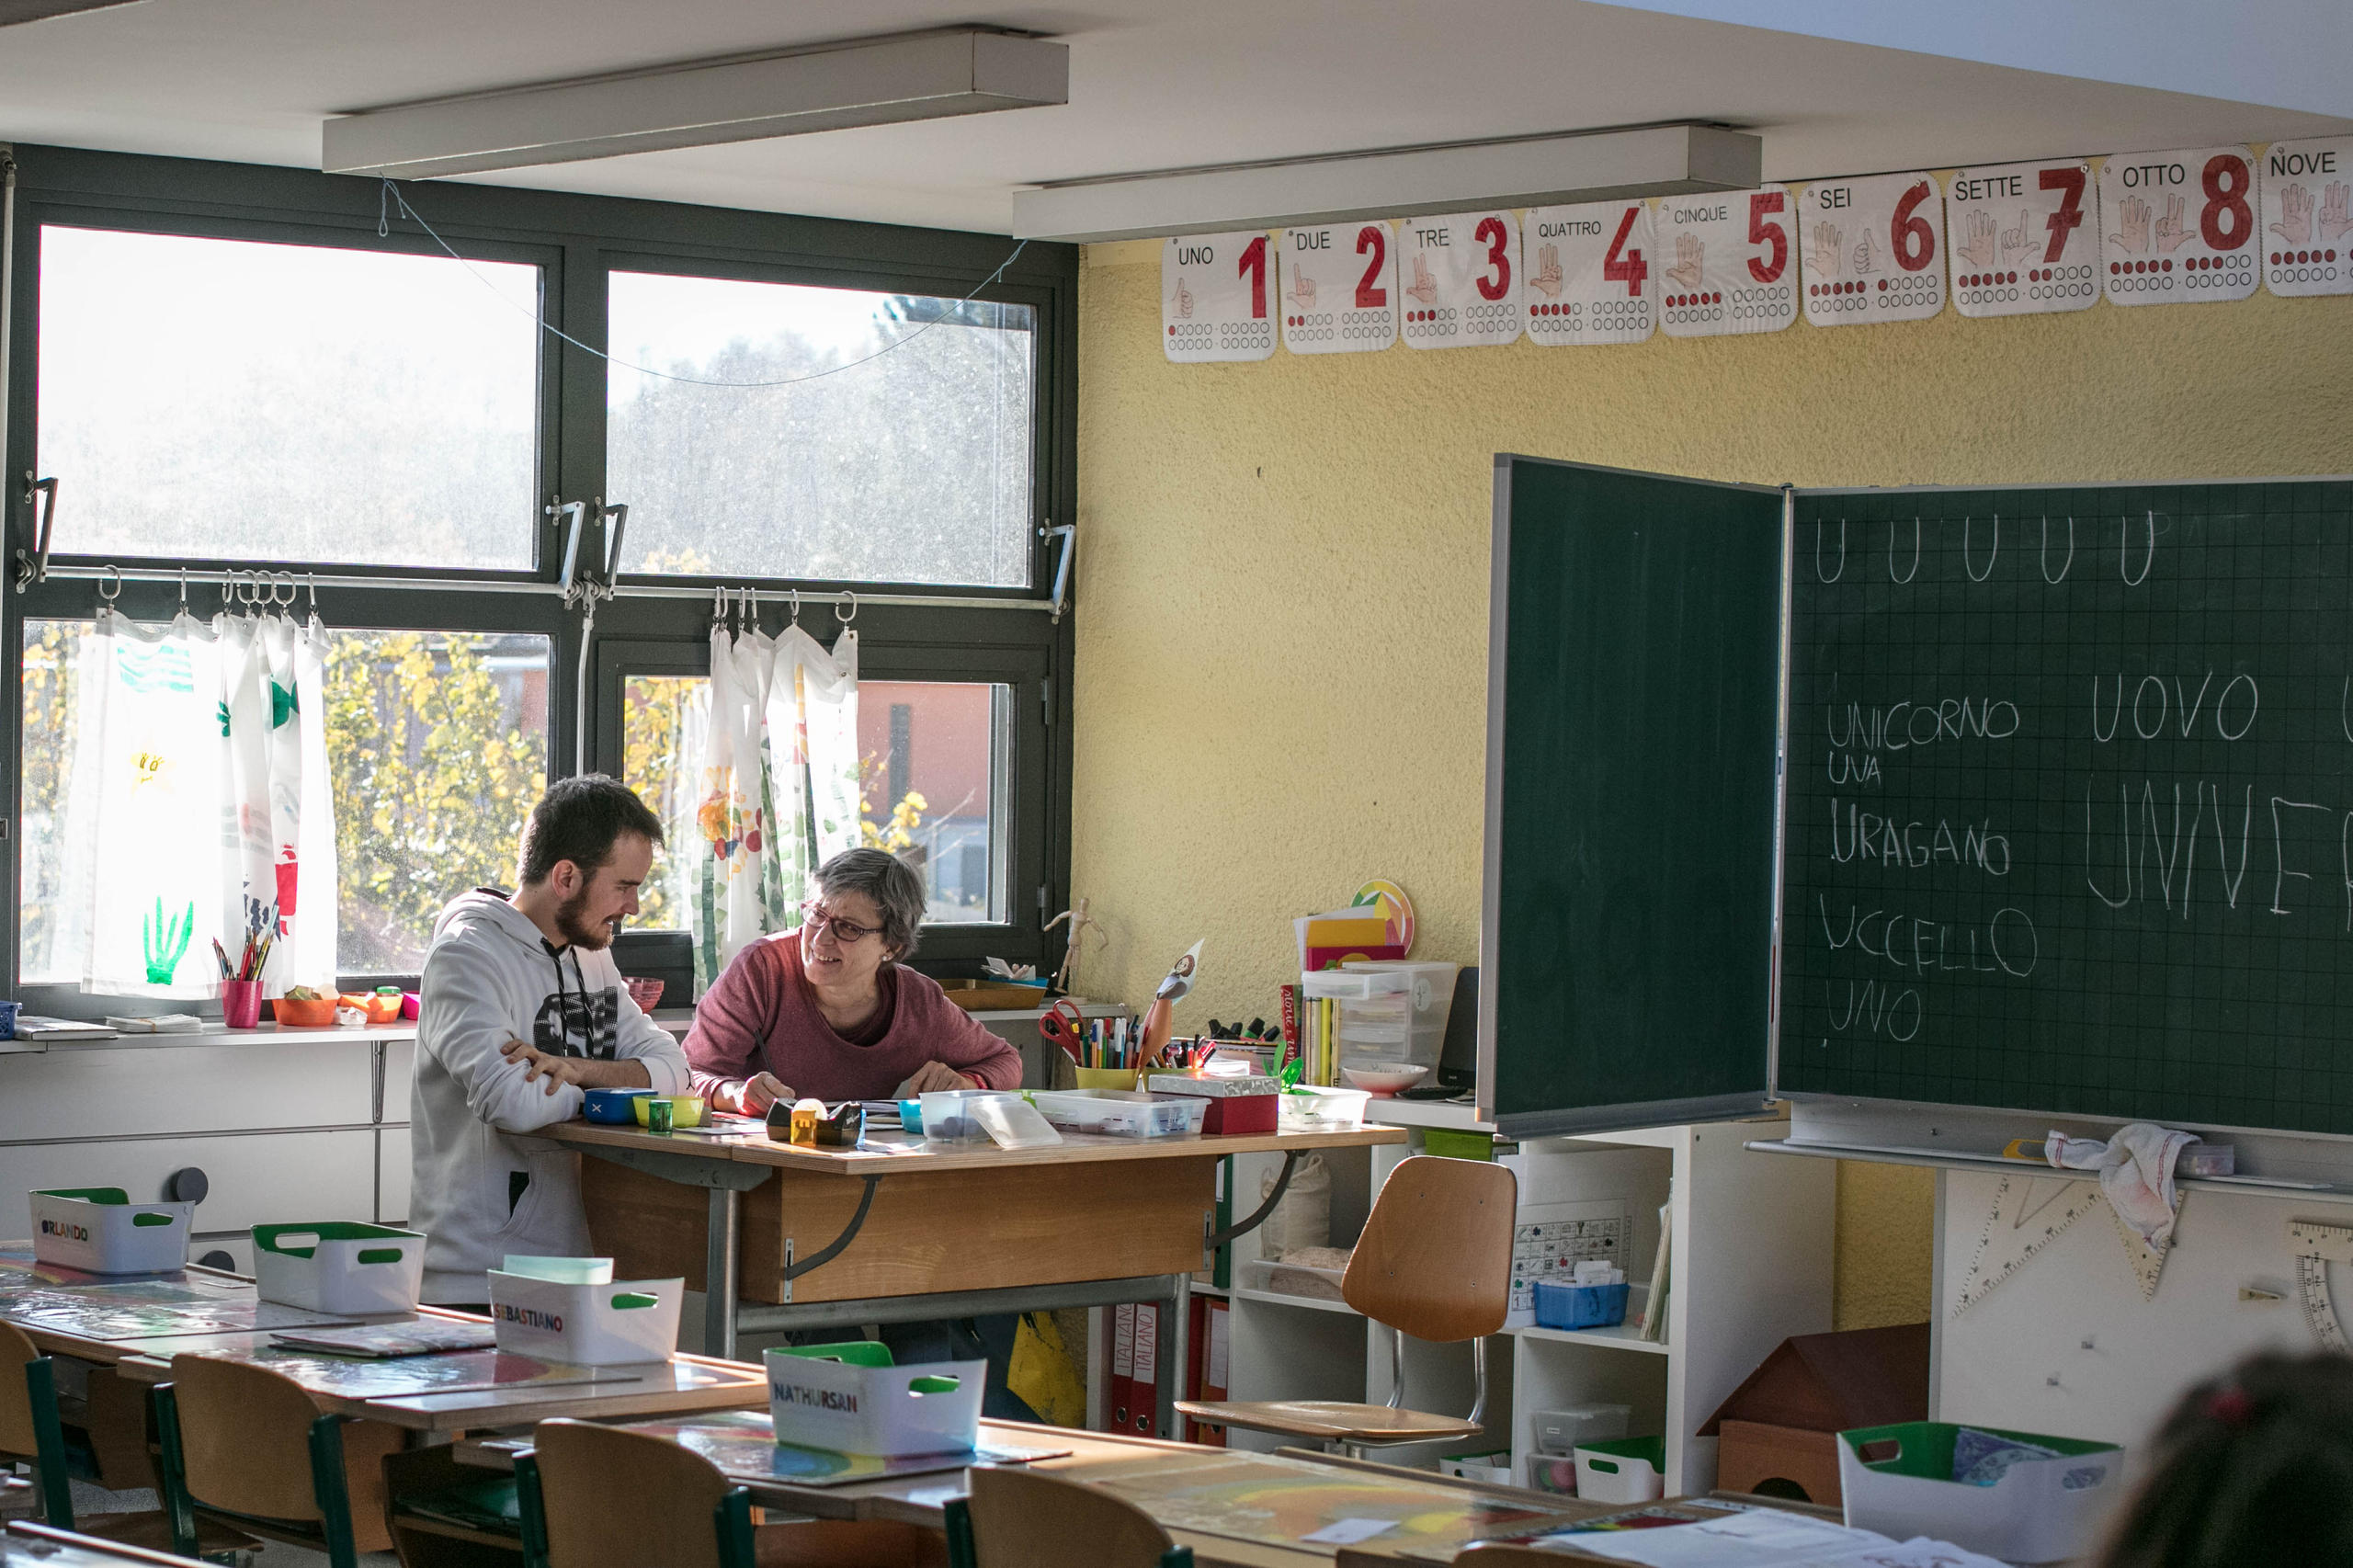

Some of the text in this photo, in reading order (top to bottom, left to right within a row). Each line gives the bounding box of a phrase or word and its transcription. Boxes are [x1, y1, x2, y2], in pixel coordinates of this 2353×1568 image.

[2121, 153, 2254, 251] OTTO 8
[2270, 151, 2336, 177] NOVE
[1538, 207, 1648, 297] QUATTRO 4
[1674, 191, 1786, 284] CINQUE 5
[1820, 180, 1936, 272] SEI 6
[1954, 167, 2086, 264] SETTE 7
[1178, 236, 1267, 319] UNO 1
[1295, 225, 1387, 308] DUE 2
[1415, 216, 1511, 301] TRE 3
[1816, 517, 1846, 584] U
[1889, 516, 1920, 585] U
[1964, 512, 1998, 582] U
[2040, 514, 2074, 585] U
[2121, 509, 2154, 586] U
[1827, 696, 2020, 751] UNICORNO
[2094, 671, 2258, 742] UOVO
[1828, 751, 1881, 787] UVA
[1830, 796, 2010, 876] URAGANO
[1820, 892, 2039, 978] UCCELLO
[1825, 979, 1921, 1041] UNO
[41, 1219, 88, 1243] ORLANDO
[494, 1301, 563, 1334] SEBASTIANO
[1135, 1312, 1154, 1371] ITALIANO
[774, 1381, 858, 1414] NATHURSAN
